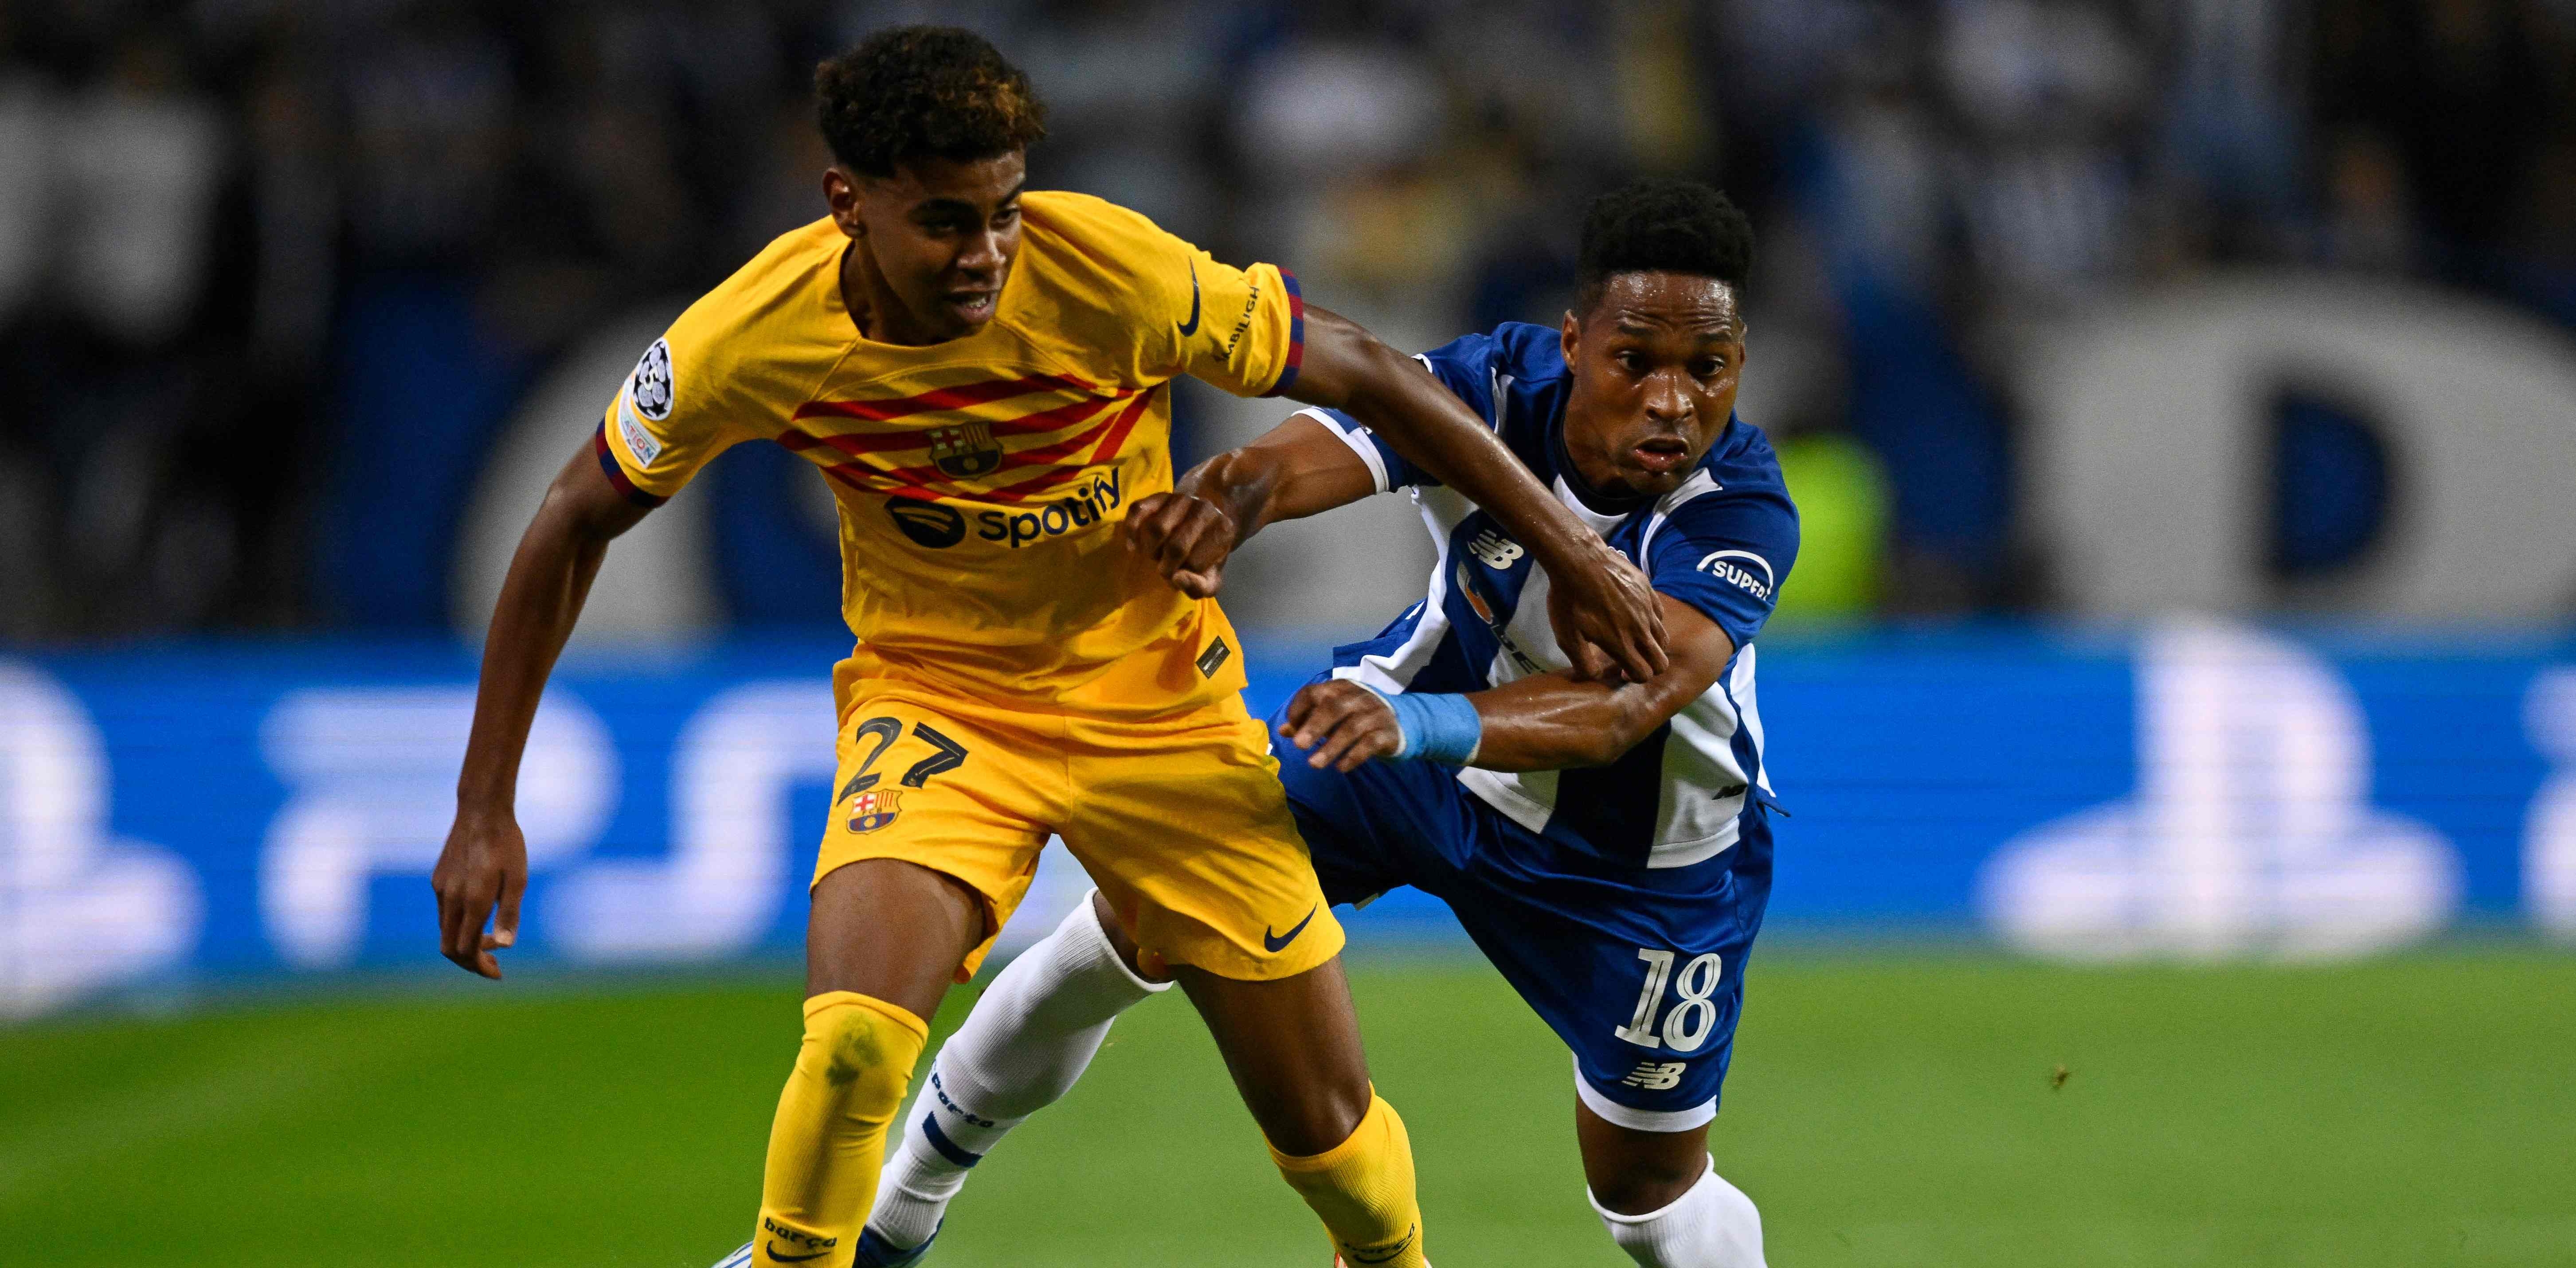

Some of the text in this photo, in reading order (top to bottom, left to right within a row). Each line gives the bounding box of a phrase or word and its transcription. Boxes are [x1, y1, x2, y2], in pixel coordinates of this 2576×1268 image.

[978, 467, 1120, 548] Spotify
[836, 716, 970, 807] 27
[1614, 948, 1722, 1052] 18
